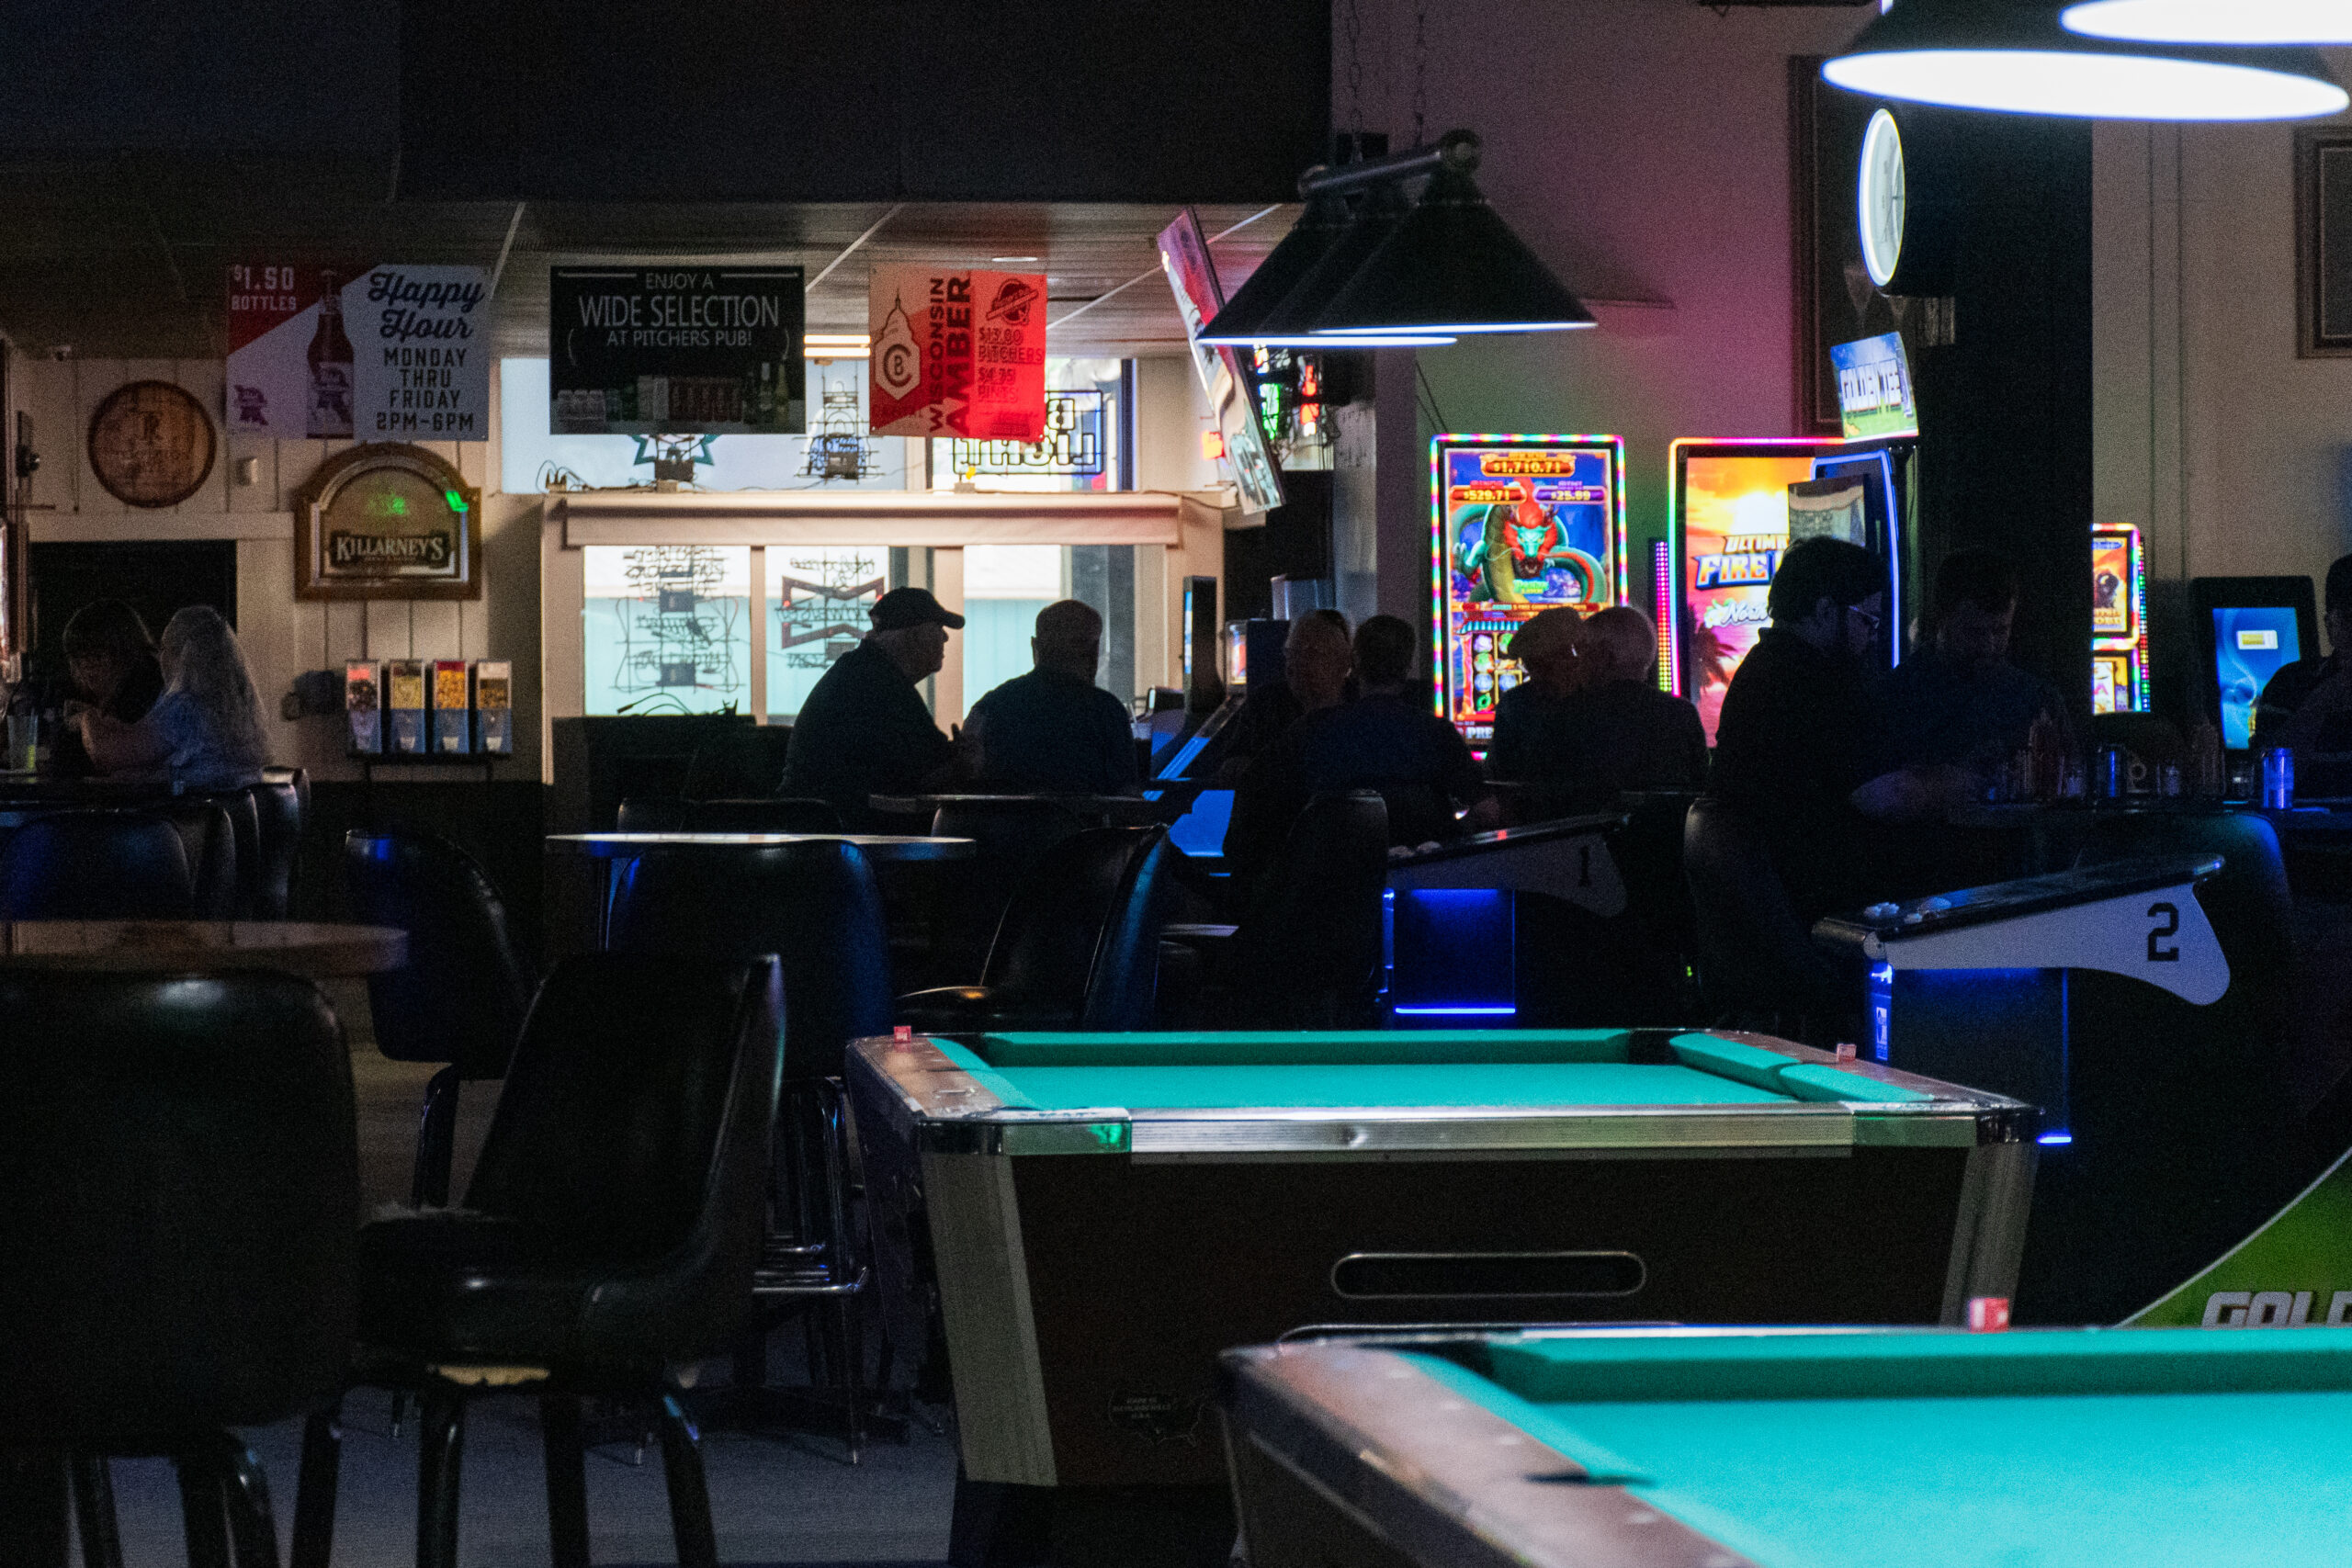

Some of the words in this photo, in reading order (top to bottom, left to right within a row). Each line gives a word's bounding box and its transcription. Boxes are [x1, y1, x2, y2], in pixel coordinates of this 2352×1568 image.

[233, 265, 295, 291] $1.50
[645, 272, 697, 290] ENJOY
[702, 272, 715, 290] A
[232, 295, 297, 311] BOTTLES
[368, 272, 485, 314] Happy
[578, 295, 643, 328] WIDE
[650, 295, 780, 328] SELECTION
[379, 309, 474, 344] Hour
[606, 330, 627, 346] AT
[633, 330, 711, 346] PITCHERS
[715, 330, 752, 346] PUB!
[383, 347, 467, 367] MONDAY
[930, 278, 944, 433] WISCONSIN
[947, 277, 970, 437] AMBER
[978, 344, 1045, 366] PITCHERS
[399, 368, 451, 389] THRU
[390, 389, 460, 410] FRIDAY
[376, 412, 474, 433] 2PM-6PM
[1698, 554, 1770, 584] FIRE
[1466, 726, 1495, 739] PRE
[1578, 846, 1592, 886] 1
[2147, 902, 2179, 962] 2
